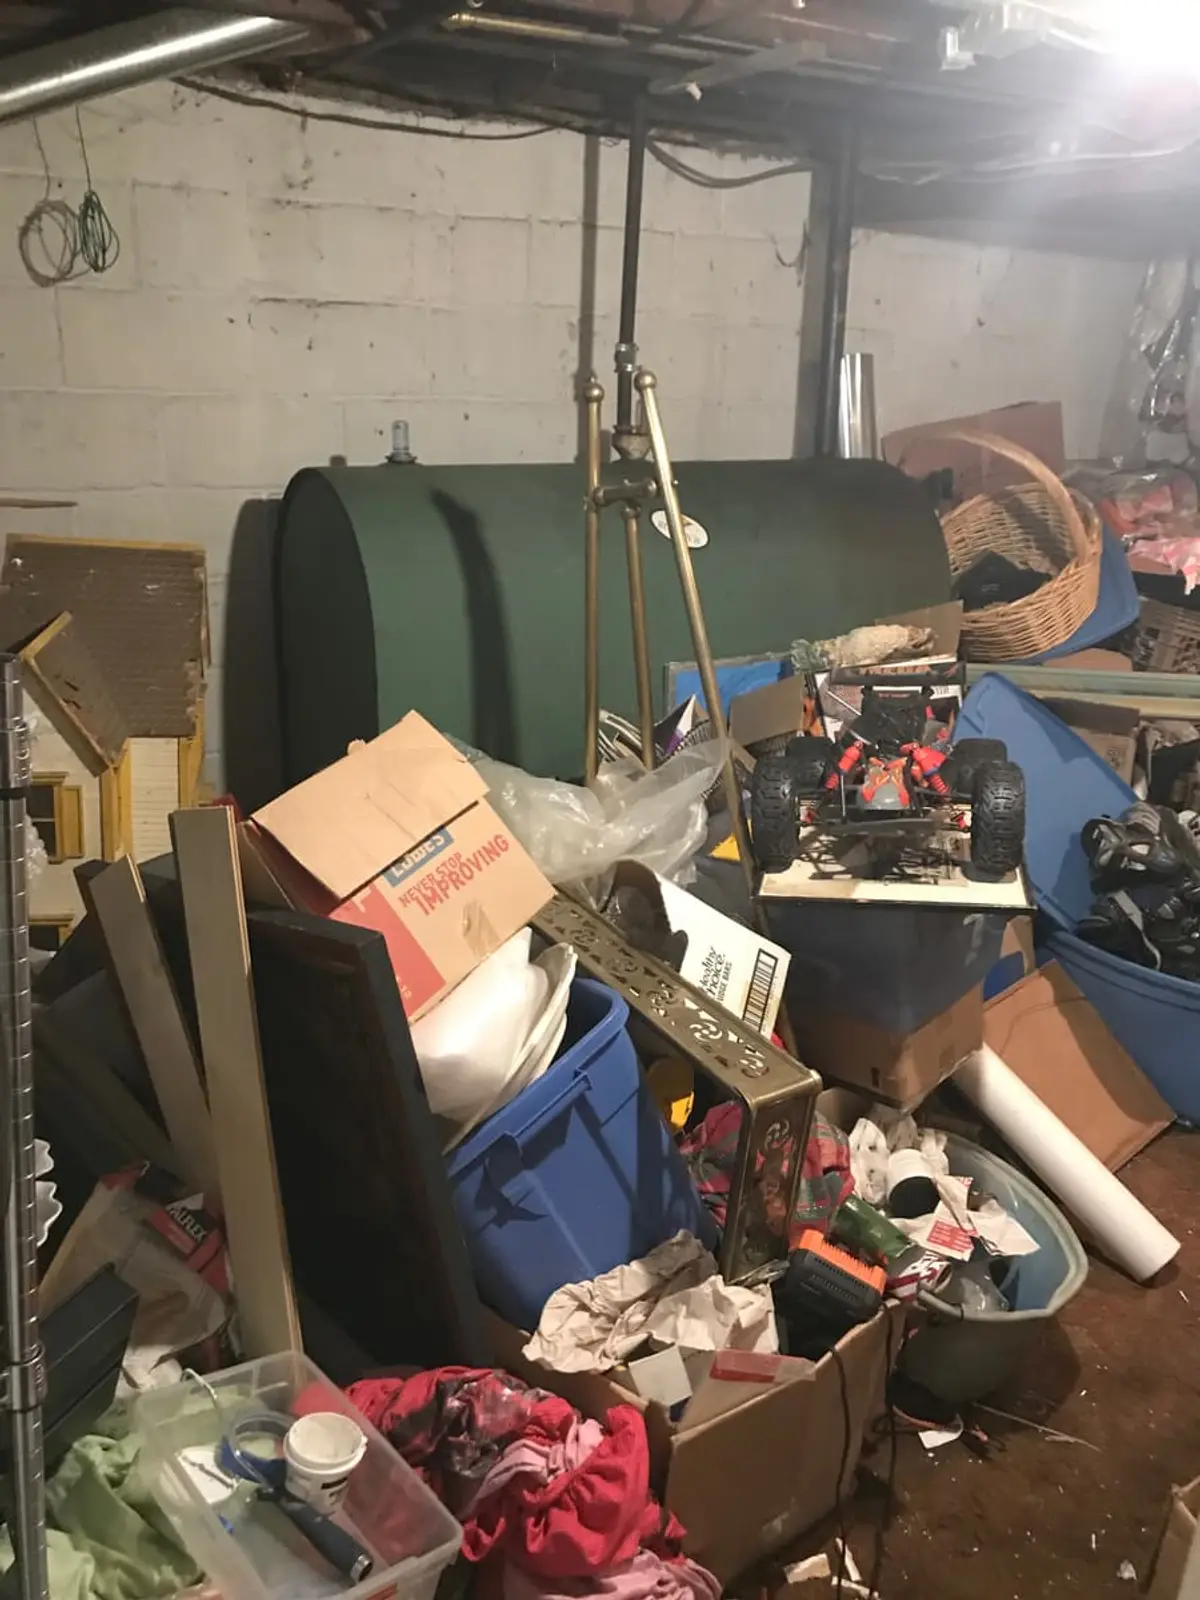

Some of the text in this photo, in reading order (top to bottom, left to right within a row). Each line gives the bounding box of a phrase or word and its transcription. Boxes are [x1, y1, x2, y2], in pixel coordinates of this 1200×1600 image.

[398, 852, 463, 908] NEVER STOP
[413, 834, 509, 916] IMPROVING
[705, 953, 725, 996] hoice
